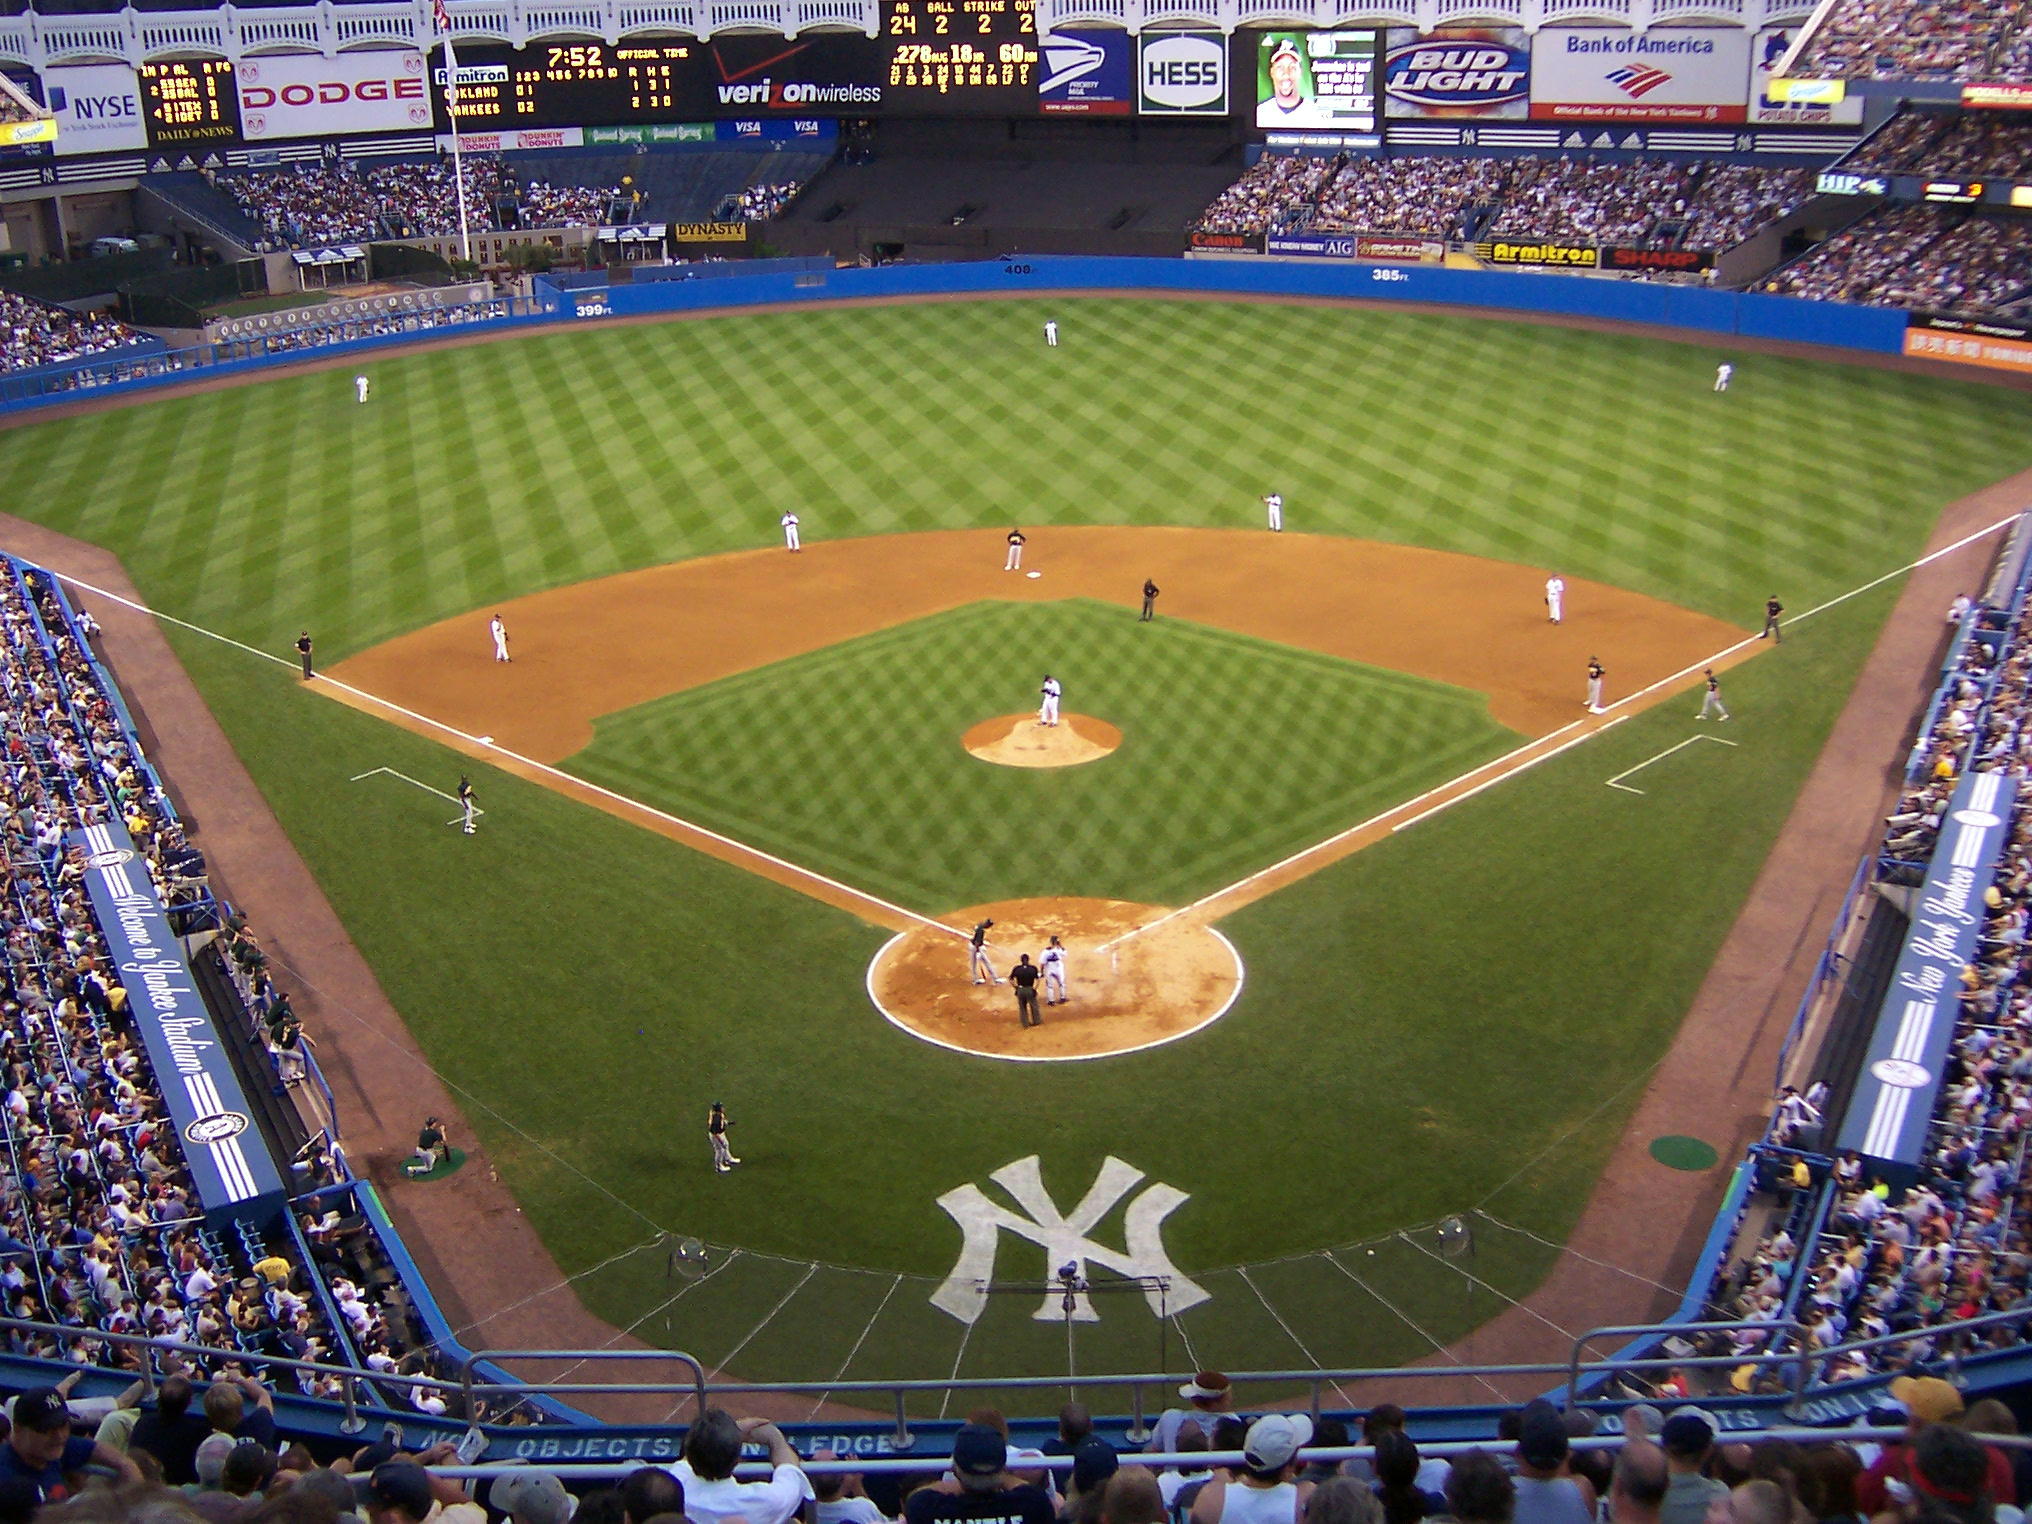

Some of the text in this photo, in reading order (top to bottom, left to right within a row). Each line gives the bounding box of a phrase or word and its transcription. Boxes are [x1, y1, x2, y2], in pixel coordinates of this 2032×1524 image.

[927, 2, 954, 14] BALL
[963, 1, 1005, 13] STRIKE
[1014, 0, 1036, 11] OUT
[890, 13, 1034, 35] 24 2 2 2
[1567, 36, 1714, 54] Bank of America
[548, 46, 602, 67] 7:52
[1409, 50, 1509, 70] BUD
[438, 68, 506, 83] Amitron
[1149, 61, 1218, 86] HESS
[1390, 71, 1527, 91] LIGHT
[242, 78, 424, 109] DODGE
[444, 86, 499, 99] OKLAND
[74, 95, 136, 119] NYSE
[157, 126, 234, 141] DAILY NEWS
[735, 121, 761, 133] VISA
[794, 121, 819, 132] VISA
[465, 142, 500, 150] DONUTS
[529, 138, 564, 147] DONUTS
[678, 223, 743, 235] DYNASTY
[1328, 241, 1352, 254] AIG
[1494, 243, 1596, 262] Armitron
[1613, 251, 1698, 267] SHARP
[1899, 867, 1976, 1004] New York Yankees
[114, 894, 214, 1074] Welcome to Yankee Stadium
[929, 1154, 1212, 1324] NY
[516, 1437, 672, 1457] OBJECTS
